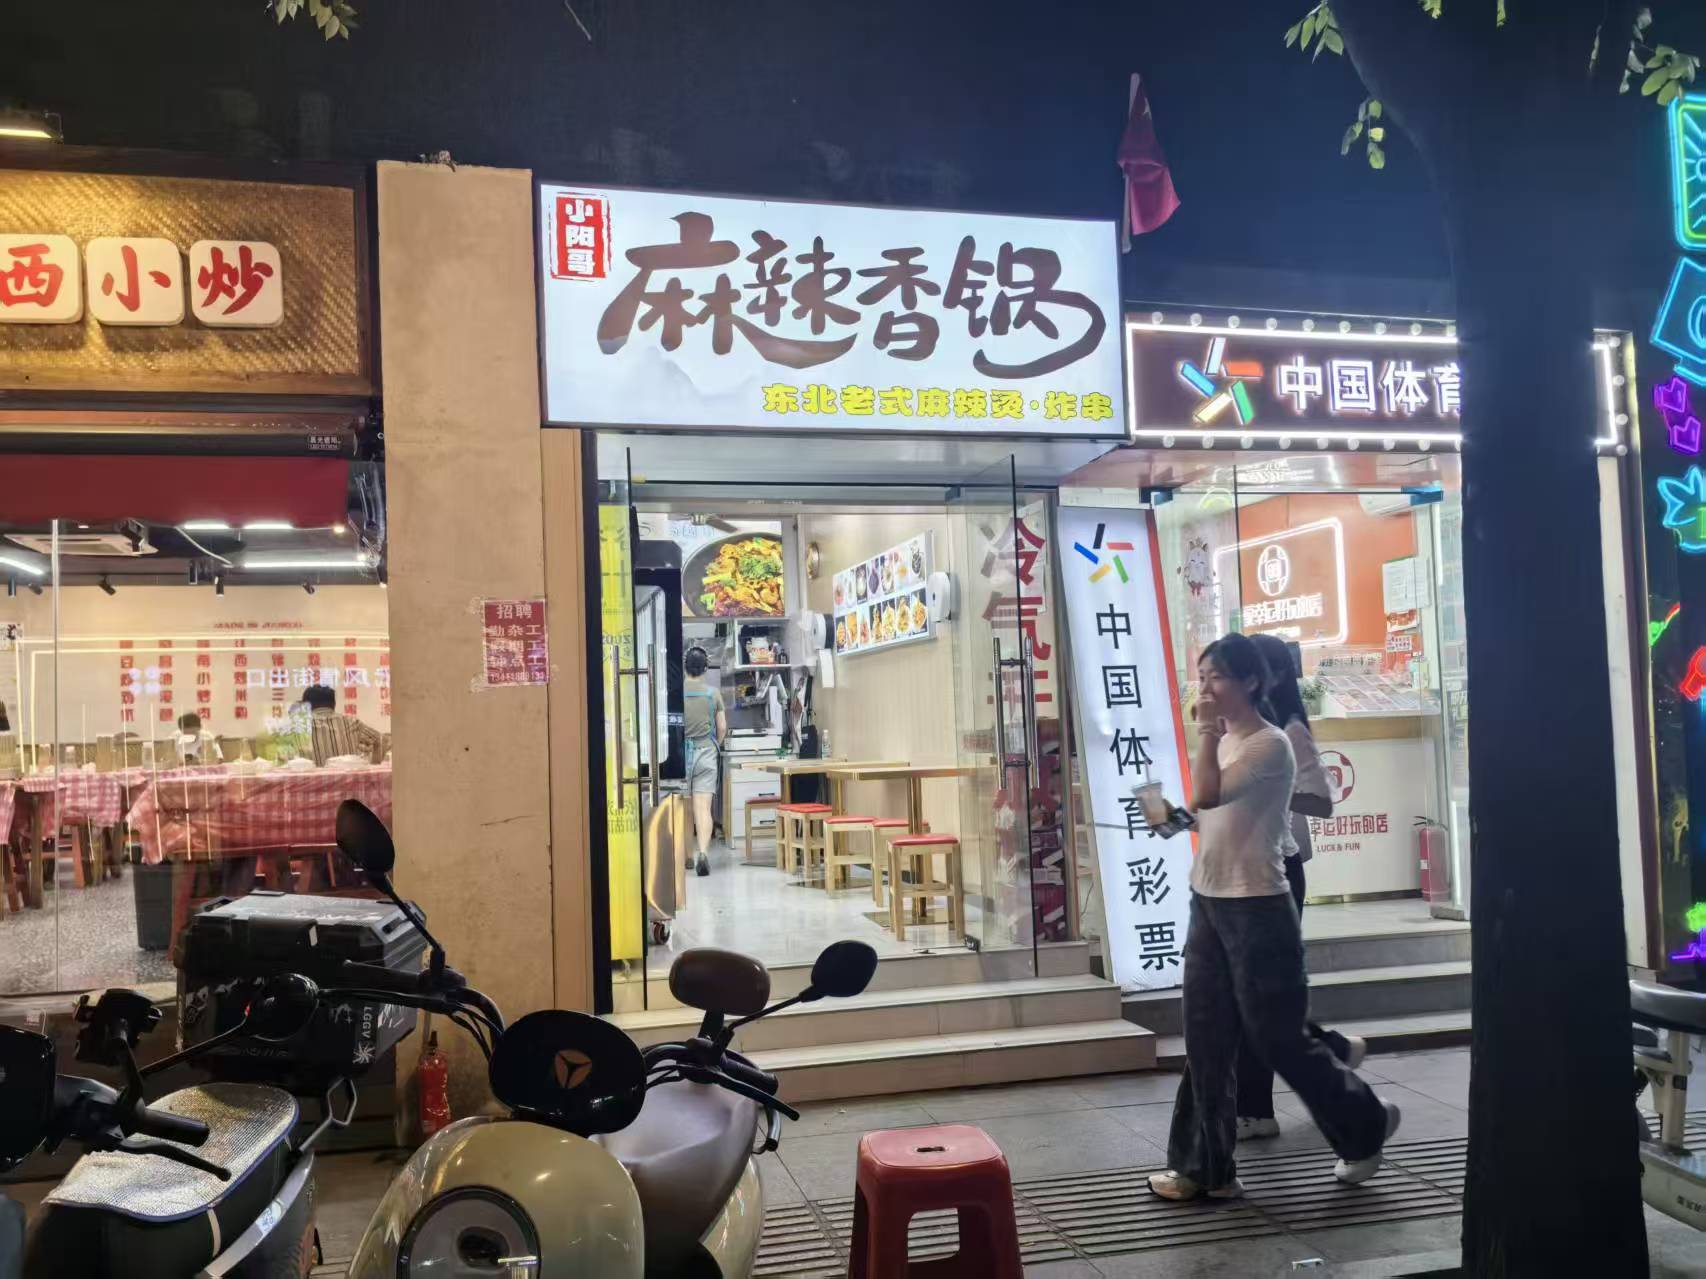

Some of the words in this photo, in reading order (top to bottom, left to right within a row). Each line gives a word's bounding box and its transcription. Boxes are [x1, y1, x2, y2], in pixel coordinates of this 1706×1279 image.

[564, 199, 596, 275] 小阳哥
[0, 243, 273, 315] 西小炒
[597, 211, 1107, 379] 麻辣香锅
[761, 383, 1114, 421] 东北老式麻辣烫·炸串
[496, 604, 533, 619] 招聘
[1094, 603, 1181, 972] 中国体育彩票
